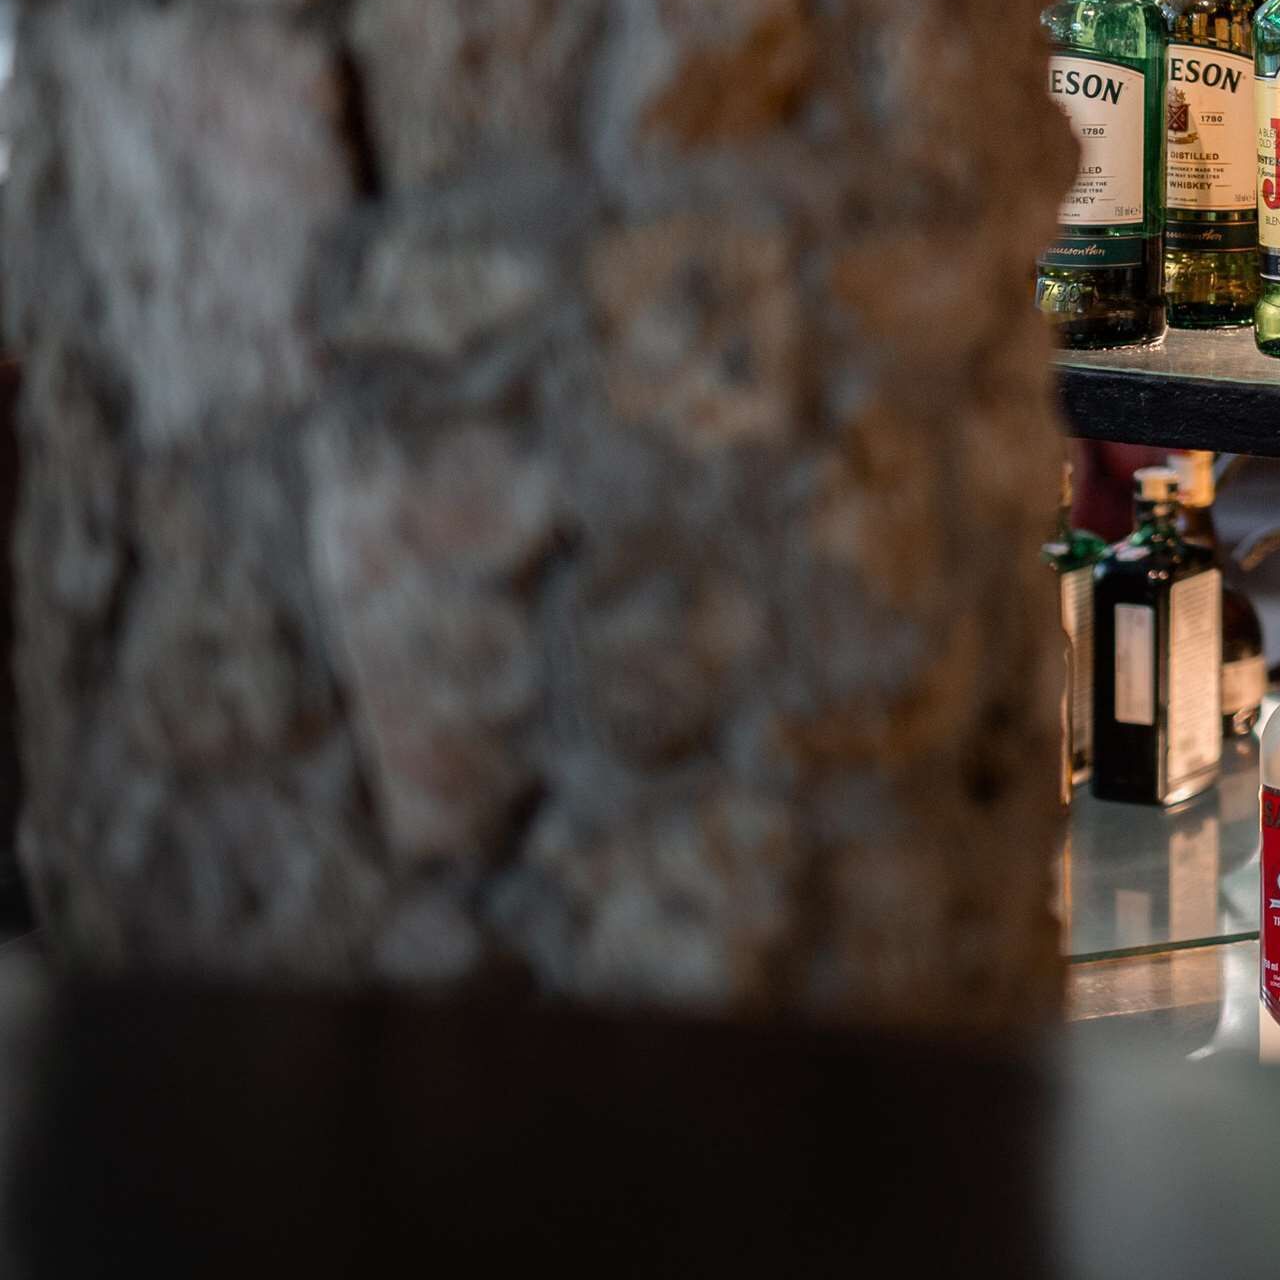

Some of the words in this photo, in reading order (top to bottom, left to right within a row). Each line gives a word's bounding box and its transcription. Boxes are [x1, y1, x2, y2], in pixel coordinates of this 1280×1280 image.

[1170, 57, 1243, 94] ESON
[1050, 69, 1125, 106] ESON
[1201, 114, 1223, 123] 1780
[1081, 127, 1105, 136] 1780
[1170, 151, 1220, 161] DISTILLED
[1169, 181, 1213, 190] WHISKEY
